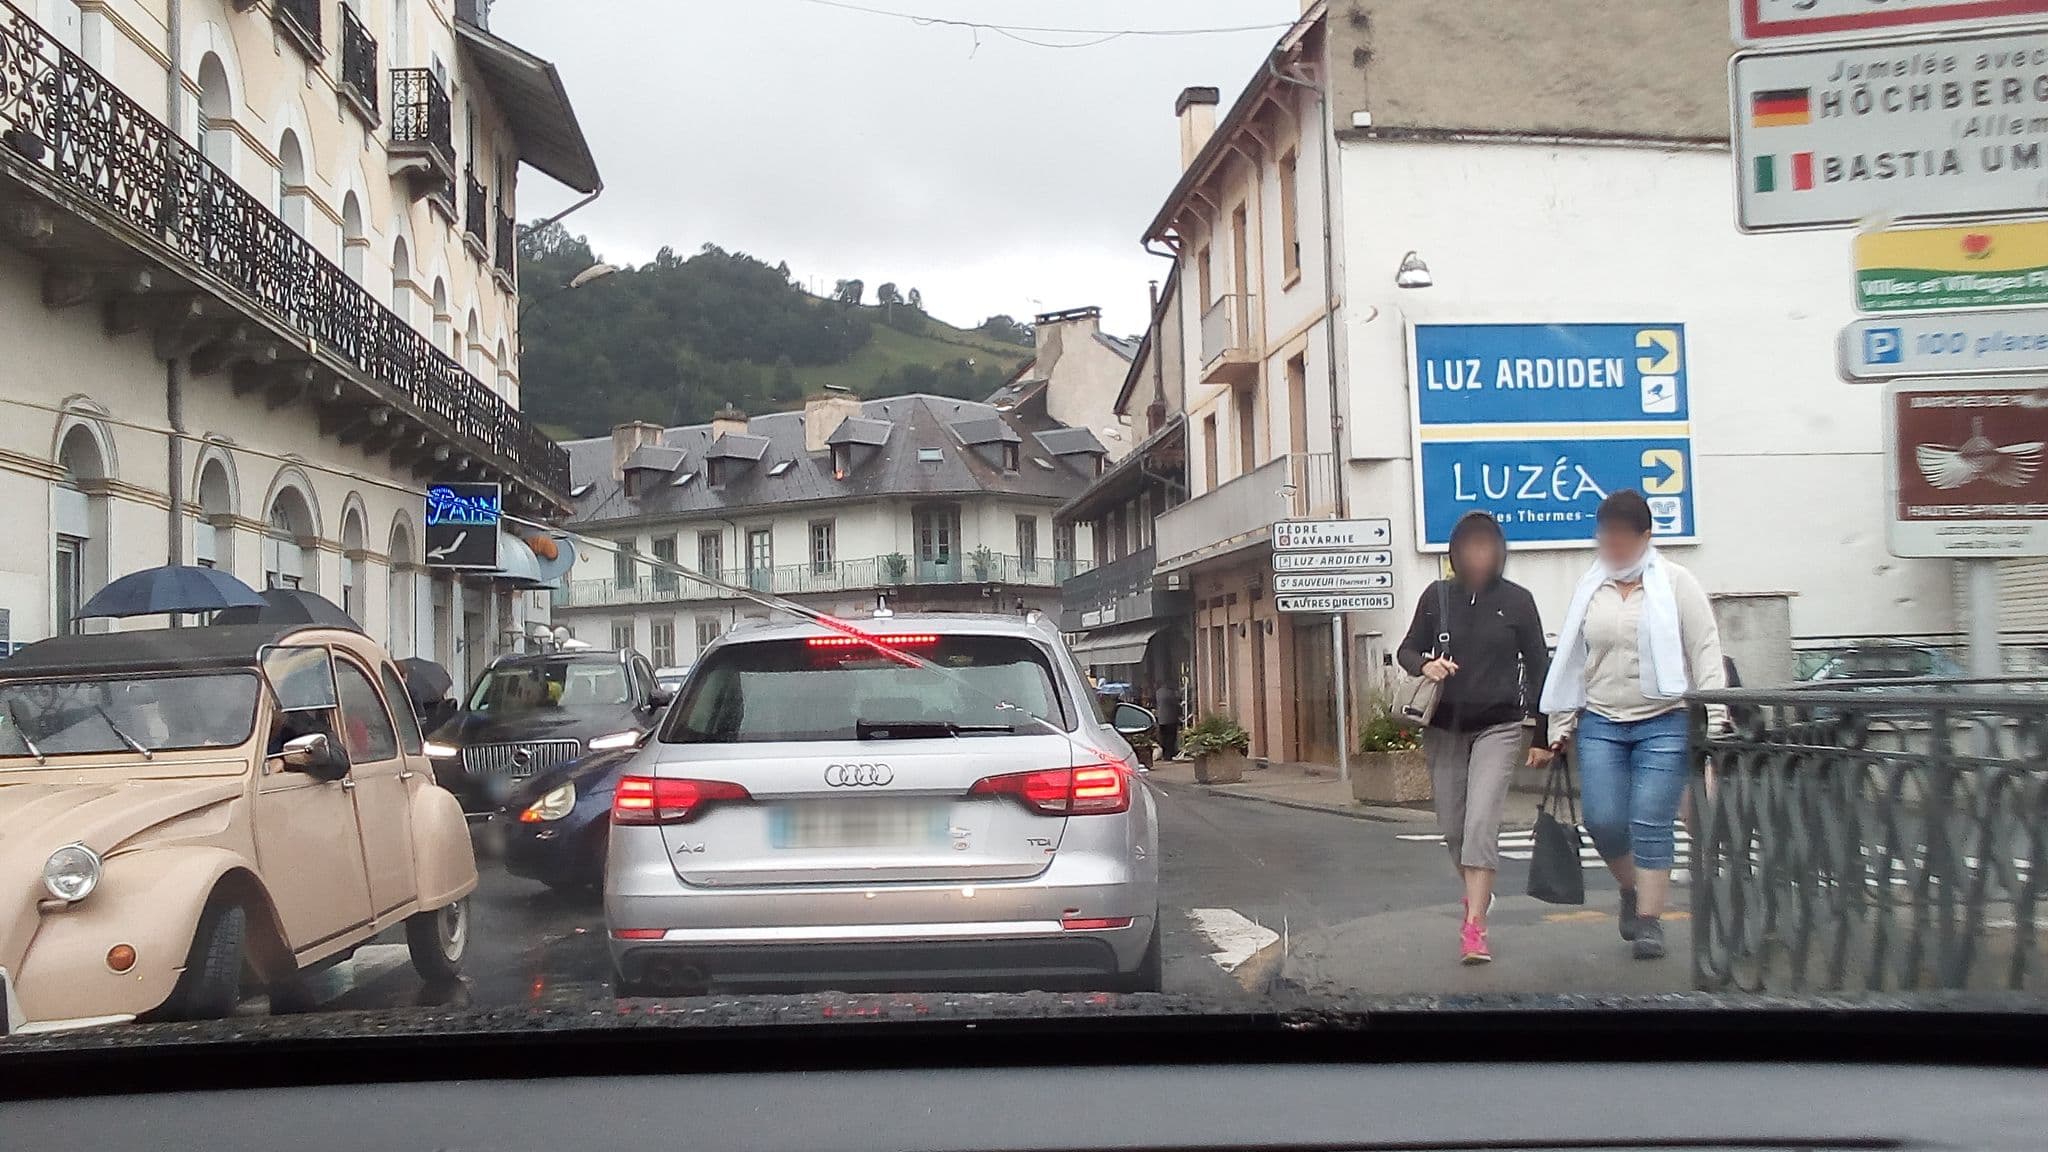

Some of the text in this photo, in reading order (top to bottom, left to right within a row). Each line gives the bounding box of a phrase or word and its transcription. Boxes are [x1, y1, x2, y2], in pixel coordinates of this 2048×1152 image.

[1975, 49, 2048, 71] avec
[1820, 75, 2048, 119] HÖCHBERG
[1823, 143, 2046, 183] BASTIA UM
[1974, 330, 2048, 359] place
[1427, 358, 1625, 391] LUZ ARDIDEN
[1453, 456, 1609, 501] LUZÉA
[1489, 509, 1582, 523] es Thermes
[1293, 535, 1354, 545] GAVARNIE
[1292, 578, 1334, 587] SAUVEUR
[1293, 597, 1389, 608] AUTRES DIRECTIONS
[676, 841, 706, 855] A4
[1026, 838, 1051, 847] TDI
